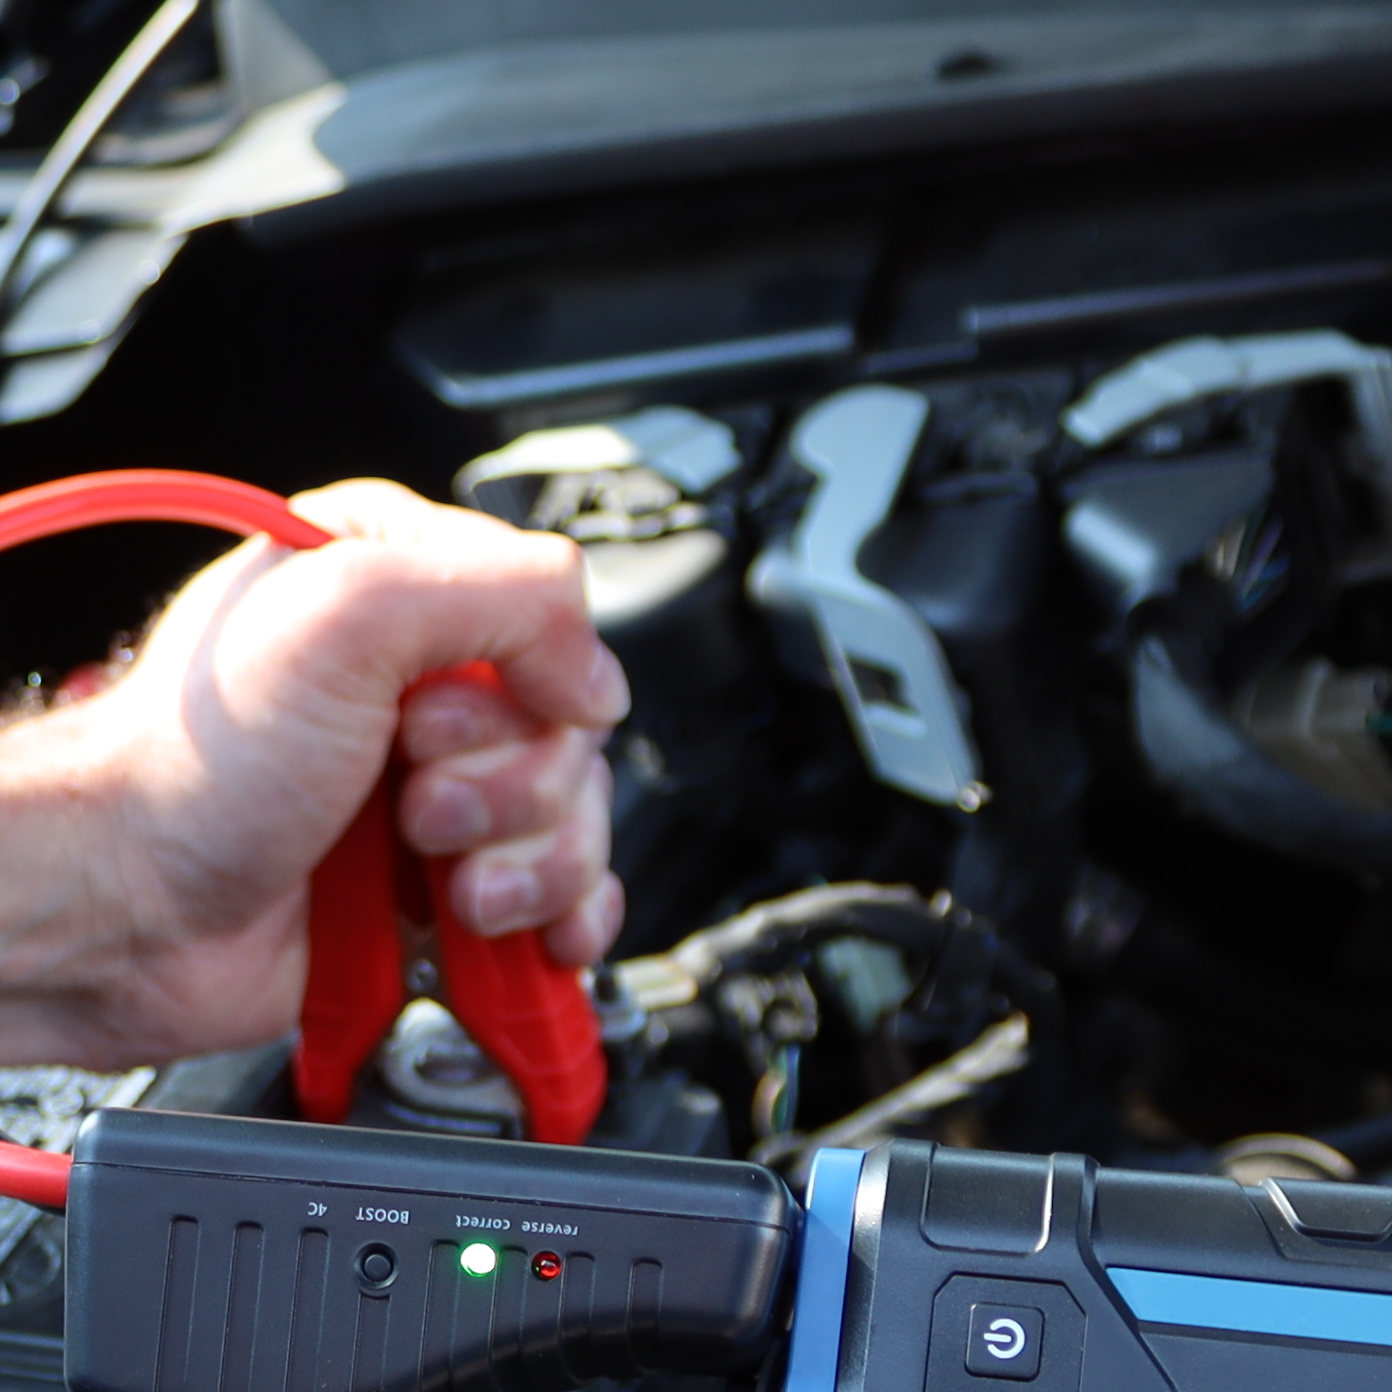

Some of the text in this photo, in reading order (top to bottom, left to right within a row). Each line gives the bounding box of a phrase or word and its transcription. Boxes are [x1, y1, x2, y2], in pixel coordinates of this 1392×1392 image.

[355, 1205, 409, 1225] BOOST
[455, 1214, 511, 1231] correct
[521, 1220, 579, 1237] reverse
